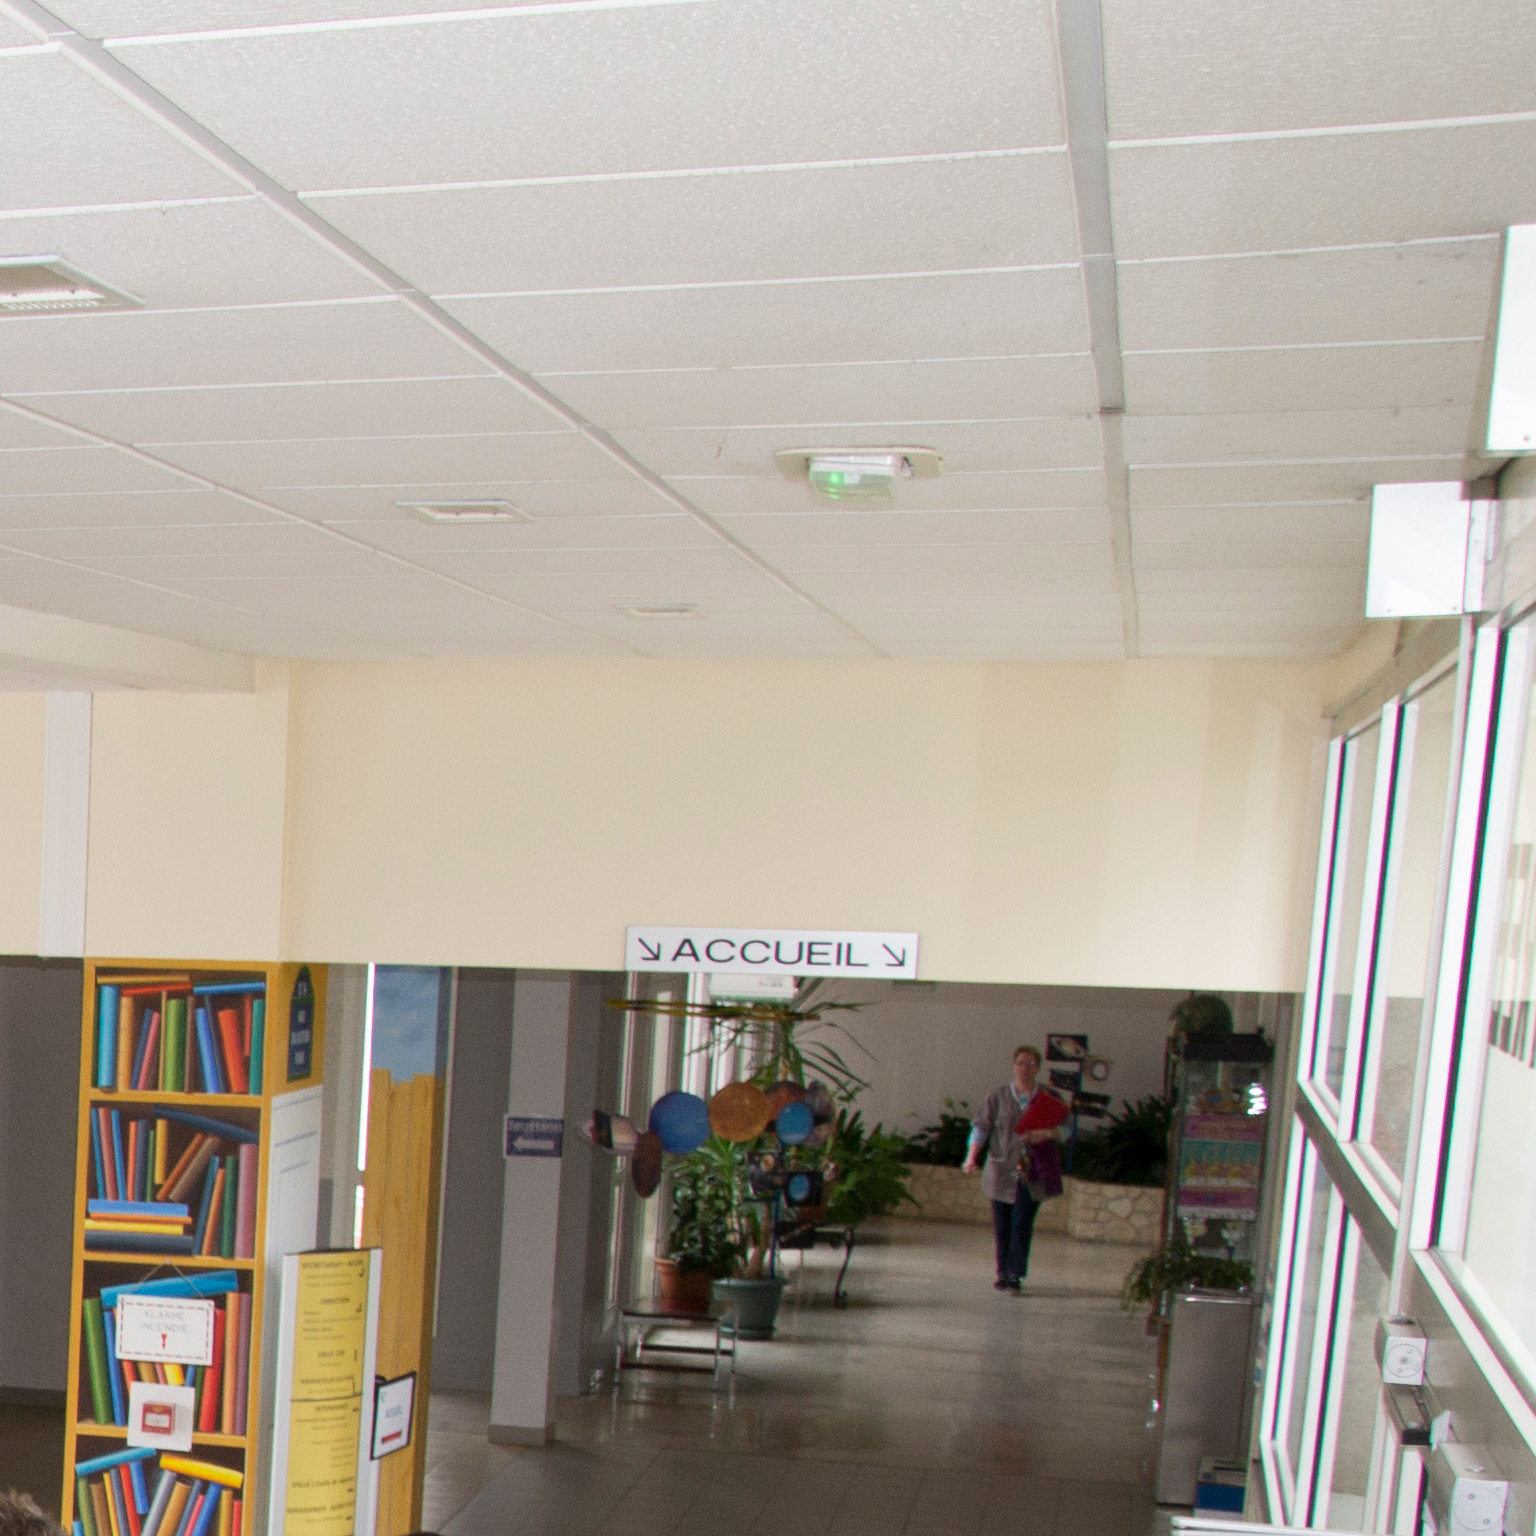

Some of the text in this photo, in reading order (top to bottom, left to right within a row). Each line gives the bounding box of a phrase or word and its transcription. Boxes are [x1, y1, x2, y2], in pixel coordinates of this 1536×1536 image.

[670, 937, 870, 967] ACCUEIL
[144, 1309, 184, 1321] ALARME
[139, 1321, 189, 1334] INCENDIE
